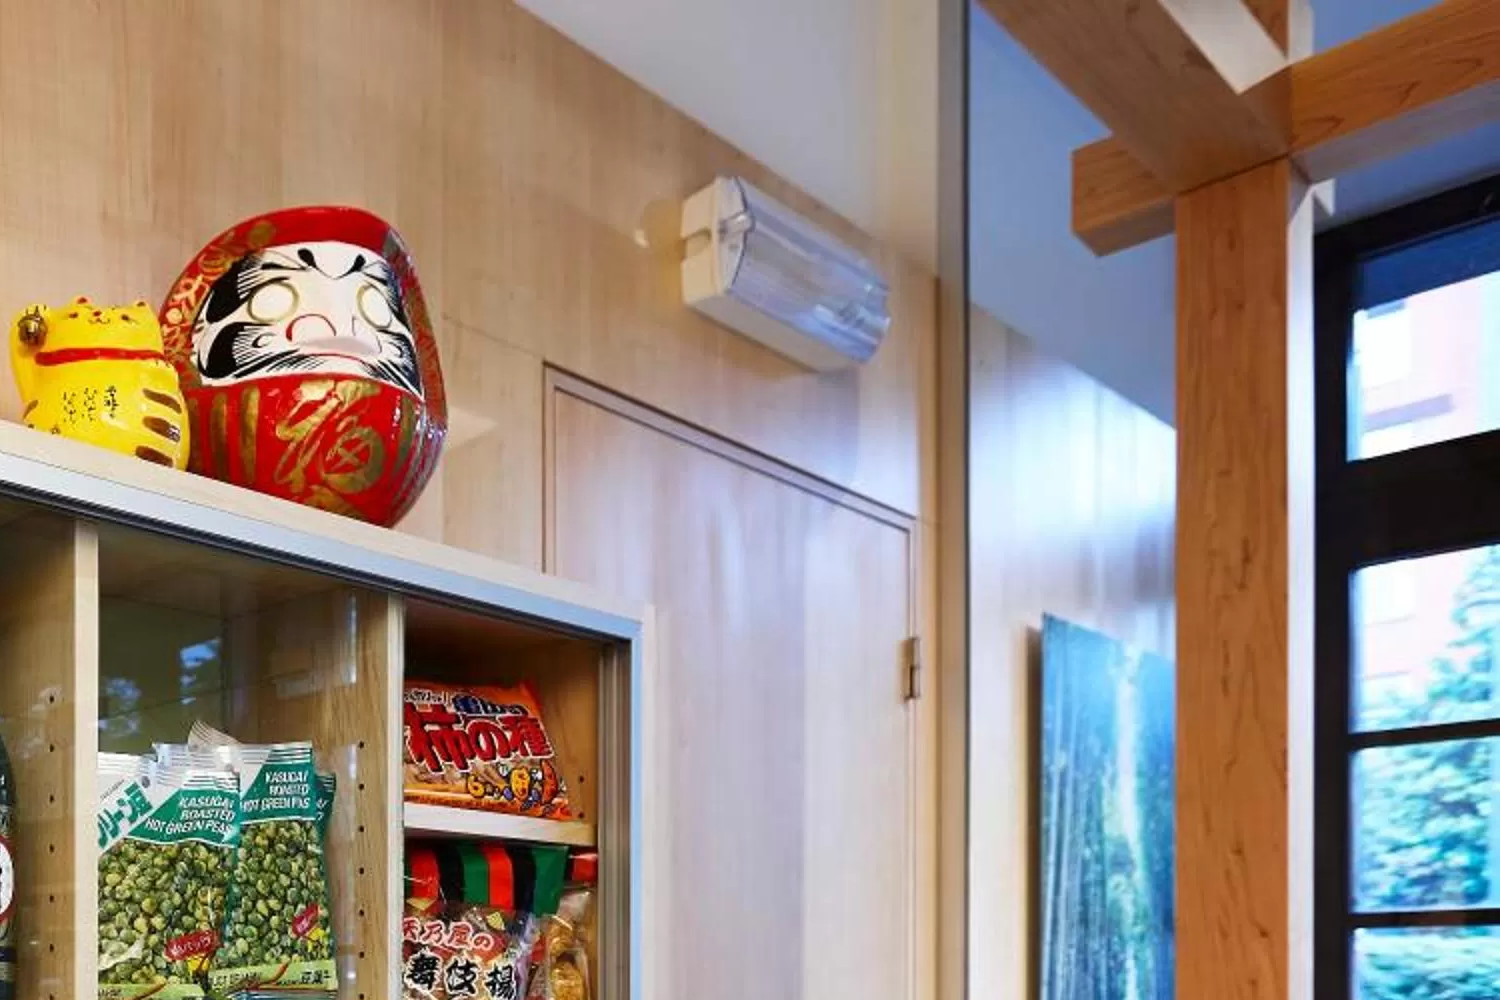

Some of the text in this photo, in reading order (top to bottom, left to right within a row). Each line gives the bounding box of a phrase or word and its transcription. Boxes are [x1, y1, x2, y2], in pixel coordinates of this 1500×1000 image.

[179, 795, 234, 809] KASUGAI
[181, 807, 236, 822] ROASTED
[146, 818, 166, 832] HOT
[165, 820, 204, 835] GREEN
